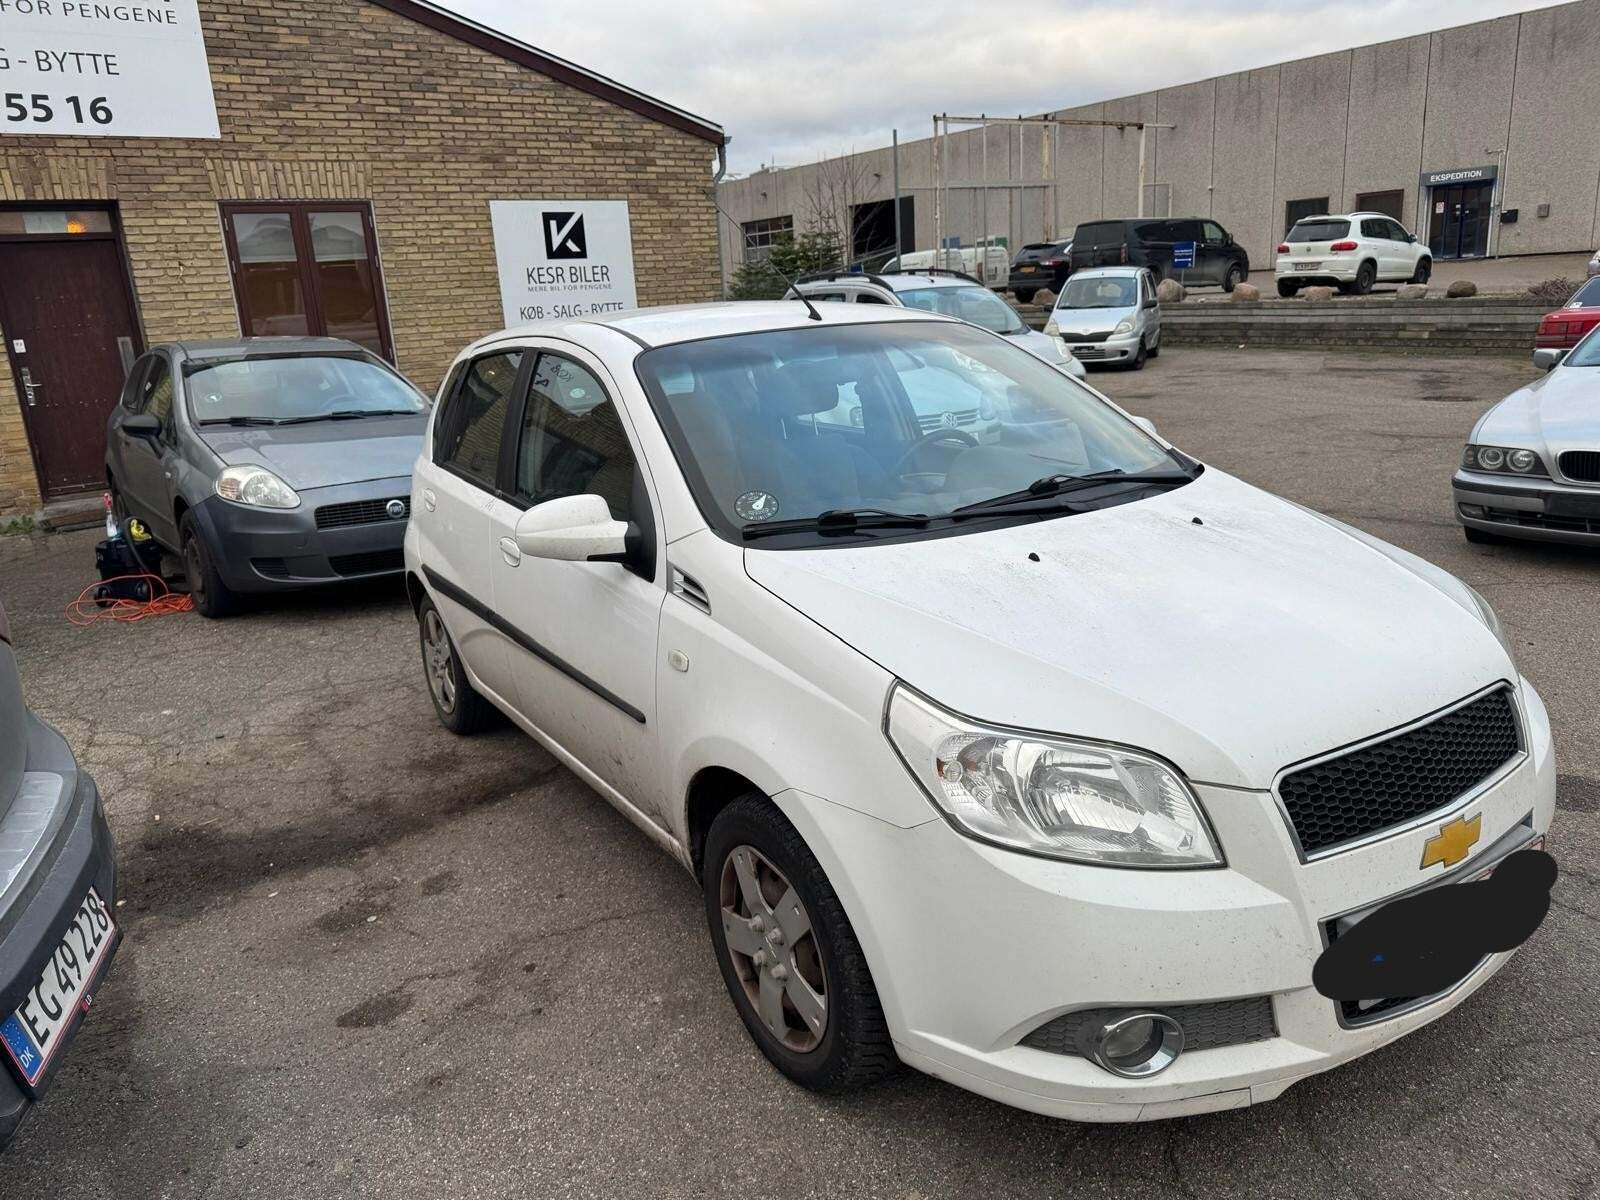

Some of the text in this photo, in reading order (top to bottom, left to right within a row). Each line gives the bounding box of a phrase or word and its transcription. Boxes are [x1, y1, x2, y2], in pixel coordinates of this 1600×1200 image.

[63, 2, 177, 24] PENGENE
[35, 50, 120, 75] BYTTE
[5, 93, 113, 124] 55 16
[1430, 170, 1482, 182] EKSPEDITION
[526, 265, 610, 284] KESR BILER
[520, 306, 544, 320] KØB
[553, 304, 582, 318] SALG
[18, 892, 109, 1048] EG 49 228
[19, 1046, 35, 1069] DK
